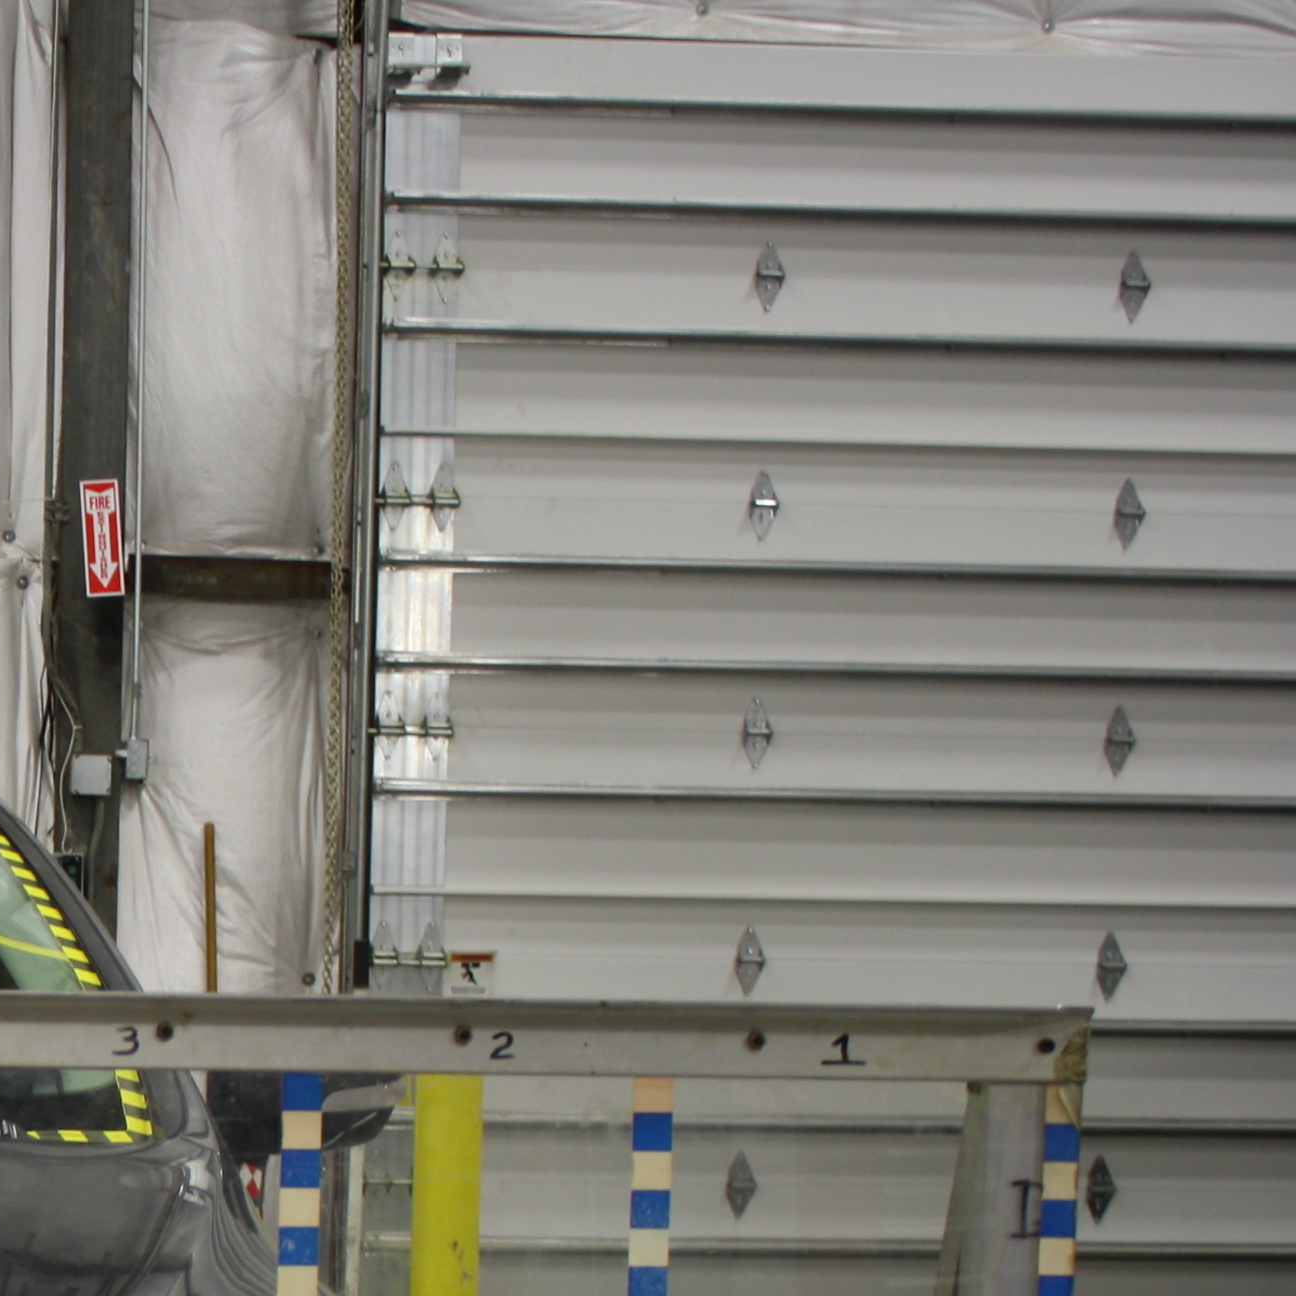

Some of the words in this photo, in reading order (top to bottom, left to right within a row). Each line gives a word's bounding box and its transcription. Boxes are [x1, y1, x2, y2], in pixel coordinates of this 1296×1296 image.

[89, 496, 111, 510] FIRE
[112, 1028, 140, 1056] 3
[490, 1033, 516, 1060] 2
[821, 1034, 868, 1066] 1
